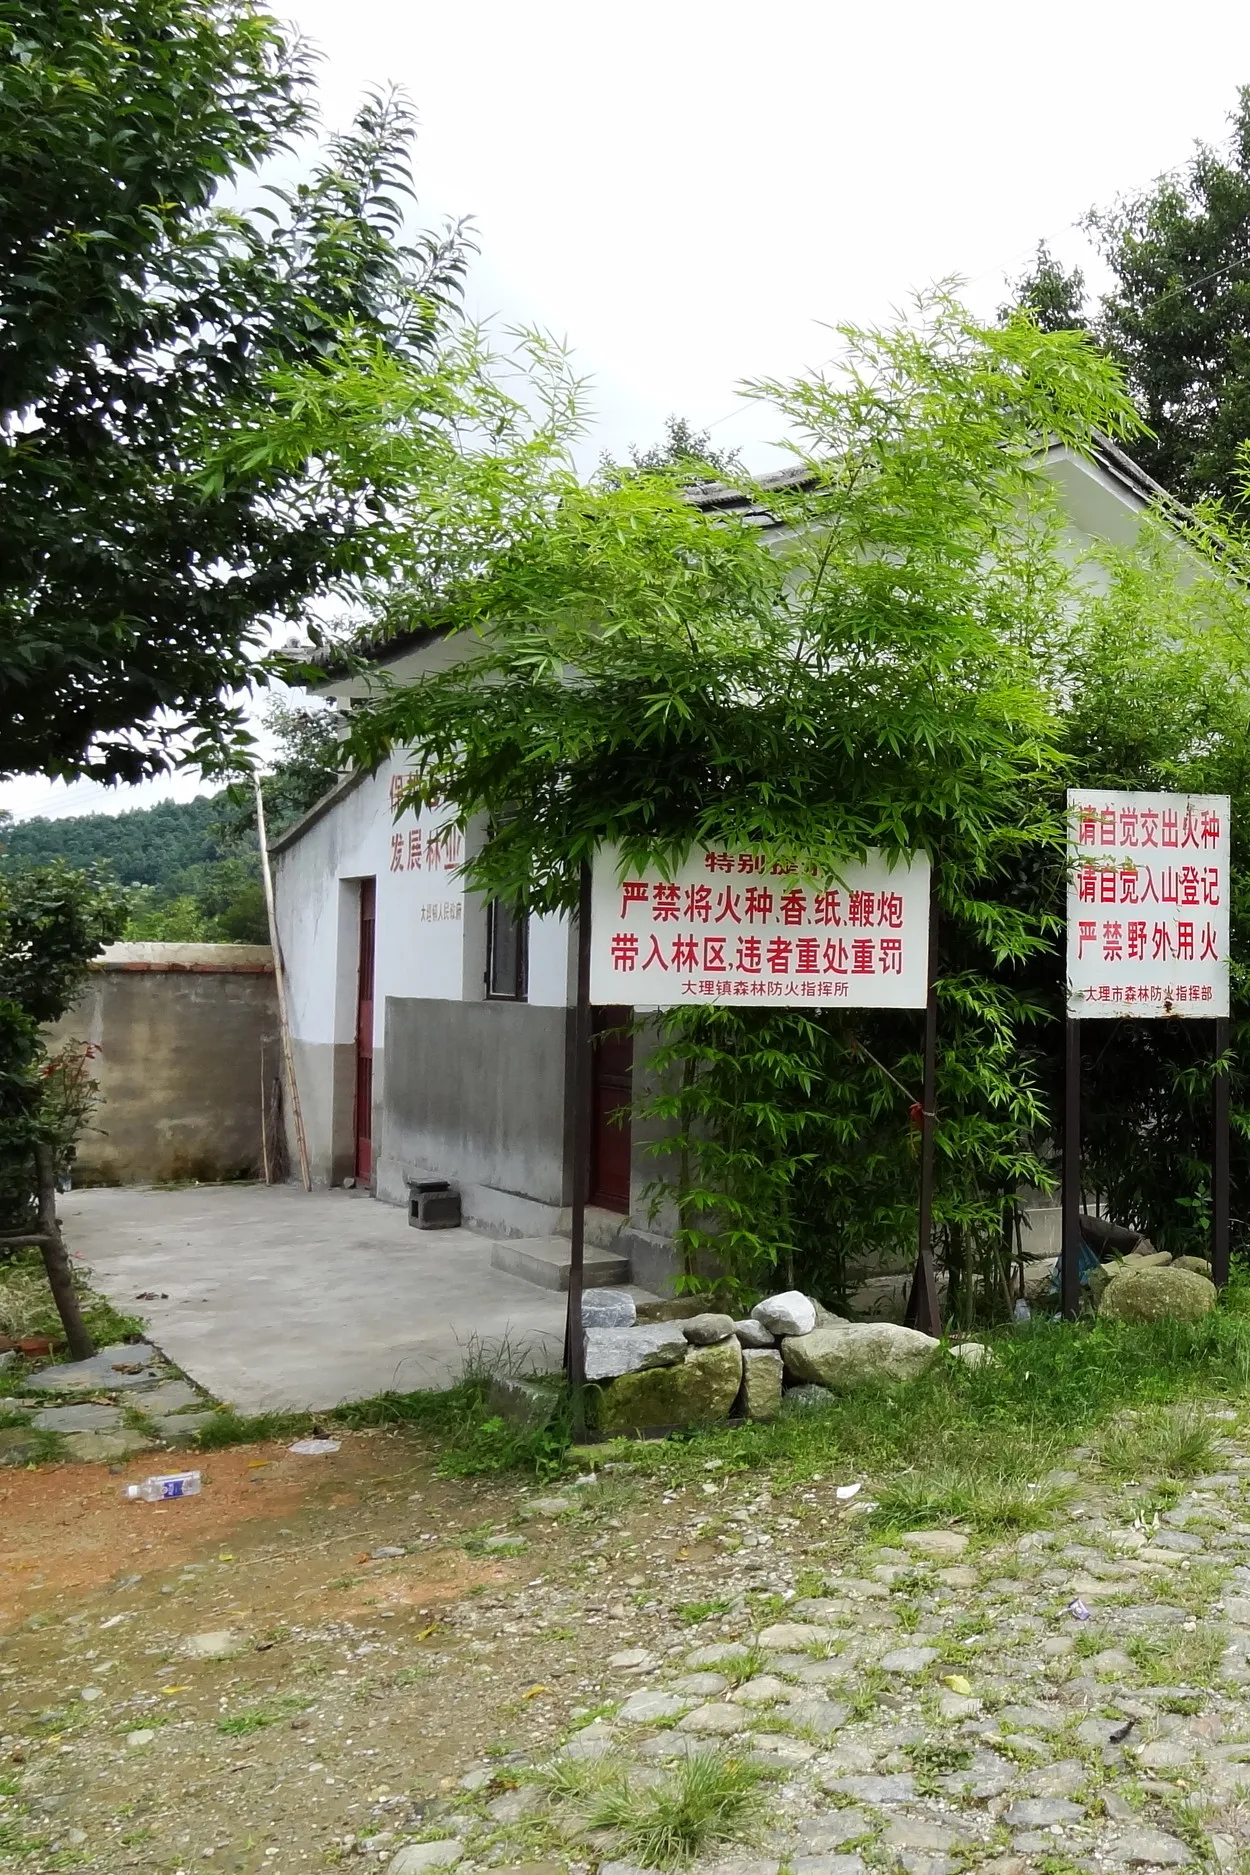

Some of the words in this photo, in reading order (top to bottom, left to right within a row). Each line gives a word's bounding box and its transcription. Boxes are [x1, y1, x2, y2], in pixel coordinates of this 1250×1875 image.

[390, 824, 462, 873] 发展林业
[1078, 804, 1220, 850] 请自觉交出火种
[620, 880, 904, 930] 严禁将火种、香、纸、鞭炮
[1077, 863, 1220, 906] 请自觉入山登记
[1078, 920, 1219, 962] 严禁野外用火
[681, 979, 850, 998] 大理镇森林防火指挥所
[1085, 984, 1213, 1002] 大理市森林防火指挥部
